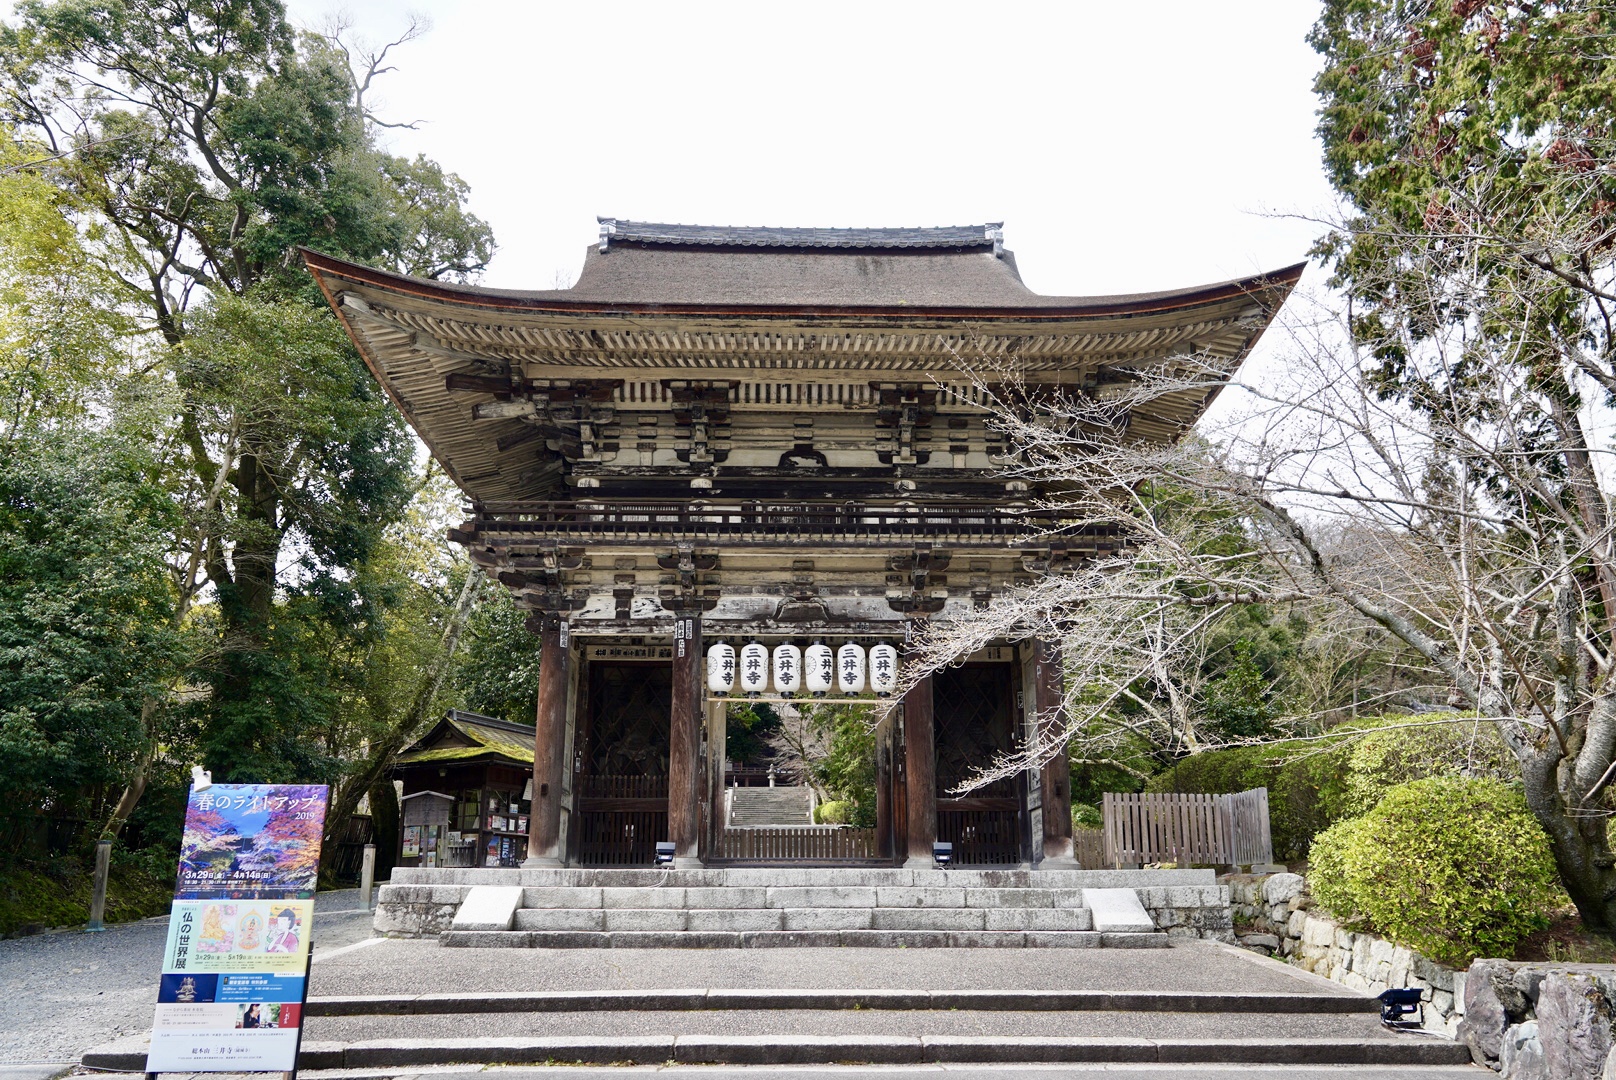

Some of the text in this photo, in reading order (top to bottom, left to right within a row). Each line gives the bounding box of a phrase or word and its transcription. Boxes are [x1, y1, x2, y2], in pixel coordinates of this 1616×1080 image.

[721, 648, 734, 686] 三井寺
[746, 647, 762, 685] 三井寺
[778, 648, 794, 686] 三井寺
[820, 648, 832, 685] 三井寺
[842, 647, 858, 685] 三井寺
[196, 793, 318, 811] 春のライトアップ
[294, 812, 316, 821] 2019
[174, 911, 193, 969] 仏の世界展
